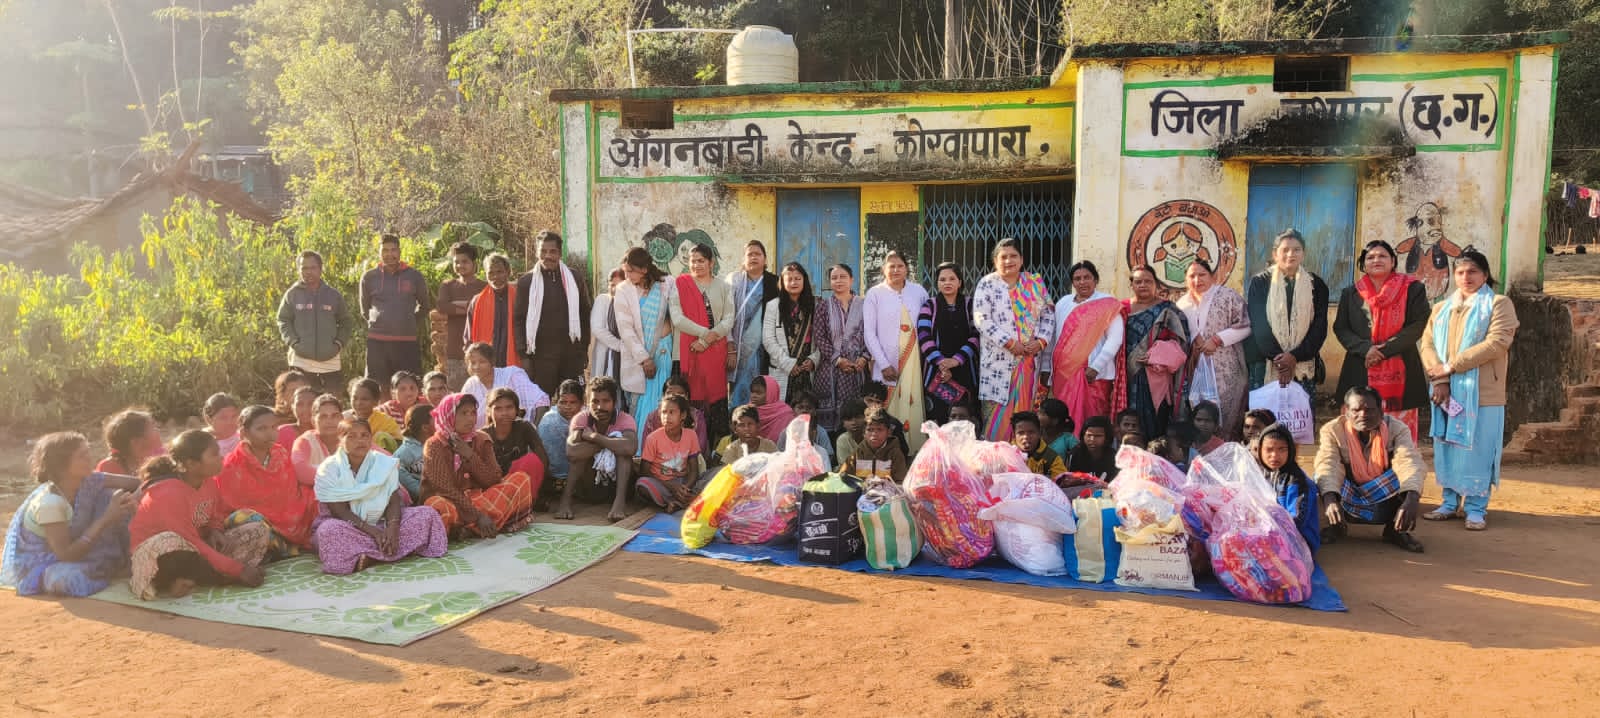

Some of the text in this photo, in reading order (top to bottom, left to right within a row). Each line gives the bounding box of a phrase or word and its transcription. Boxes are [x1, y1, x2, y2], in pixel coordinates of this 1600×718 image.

[1150, 90, 1245, 137] जिला
[1399, 82, 1498, 138] (छ.ग.)
[1160, 545, 1187, 554] BAZA
